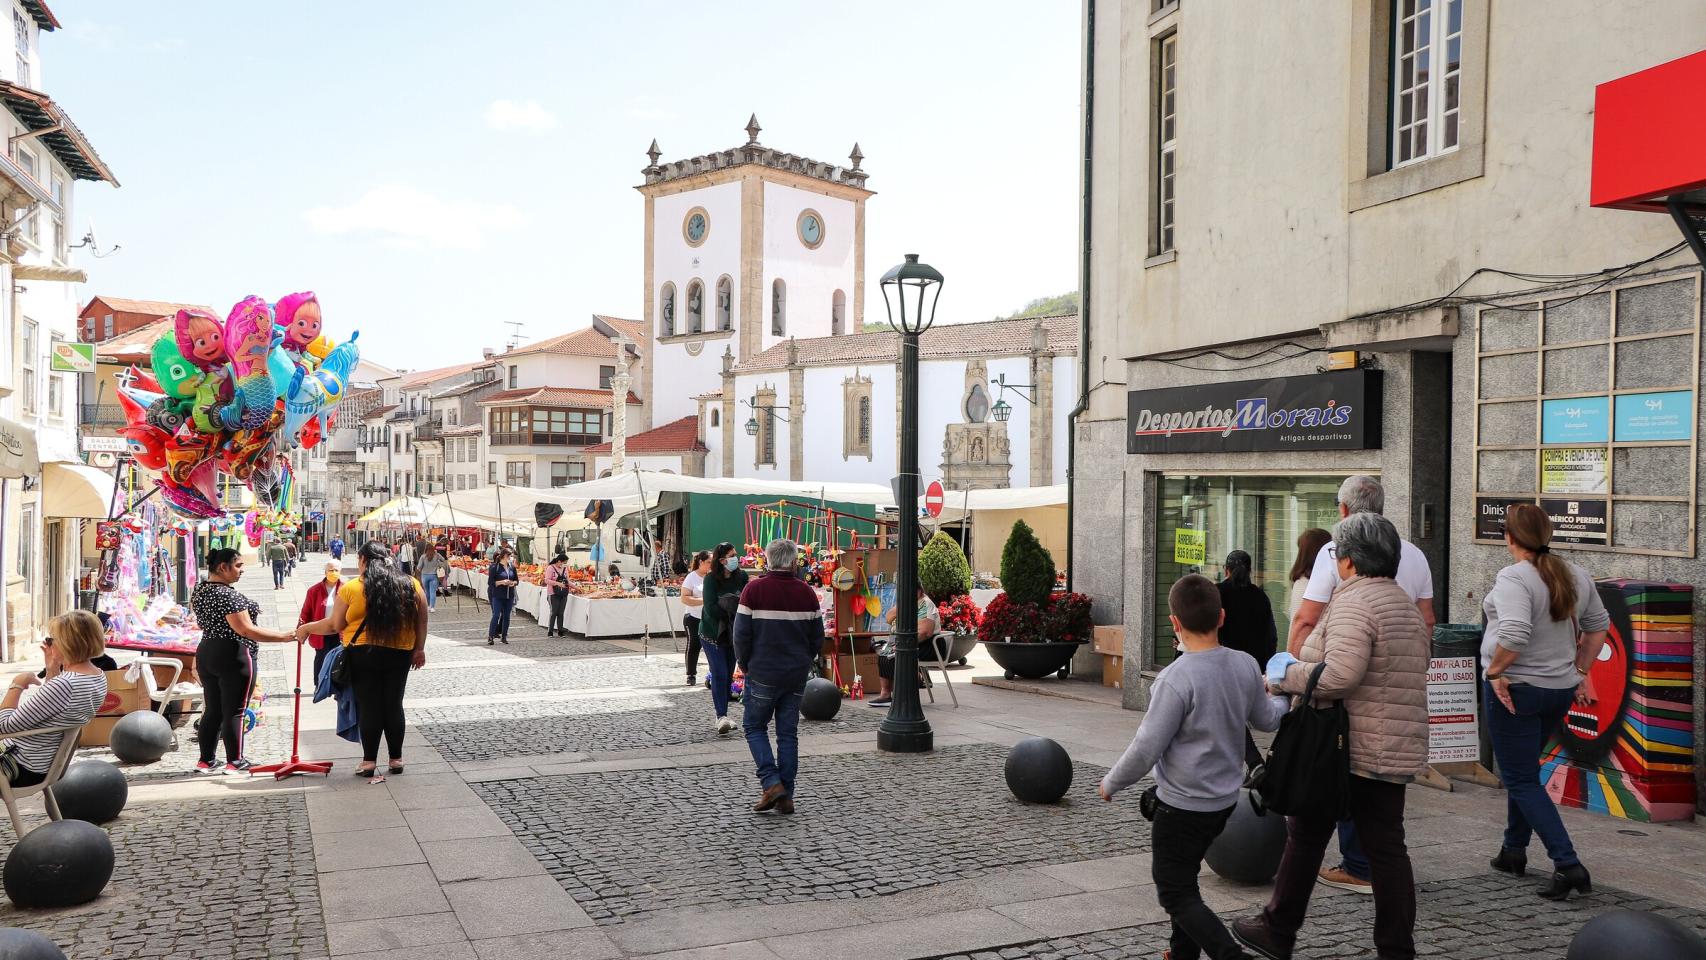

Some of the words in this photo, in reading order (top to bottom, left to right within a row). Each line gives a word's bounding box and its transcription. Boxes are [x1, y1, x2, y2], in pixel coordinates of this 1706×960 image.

[1137, 405, 1233, 437] Desportos
[1222, 400, 1352, 437] Morais
[1307, 433, 1352, 442] desportivos
[1545, 450, 1564, 461] COMPRA
[1565, 450, 1568, 461] E
[1569, 450, 1584, 461] VENDA
[1586, 450, 1592, 461] DE
[1594, 450, 1608, 461] OURO
[1482, 504, 1504, 515] Dinis
[1431, 660, 1460, 669] OMPRA
[1462, 660, 1473, 668] DE
